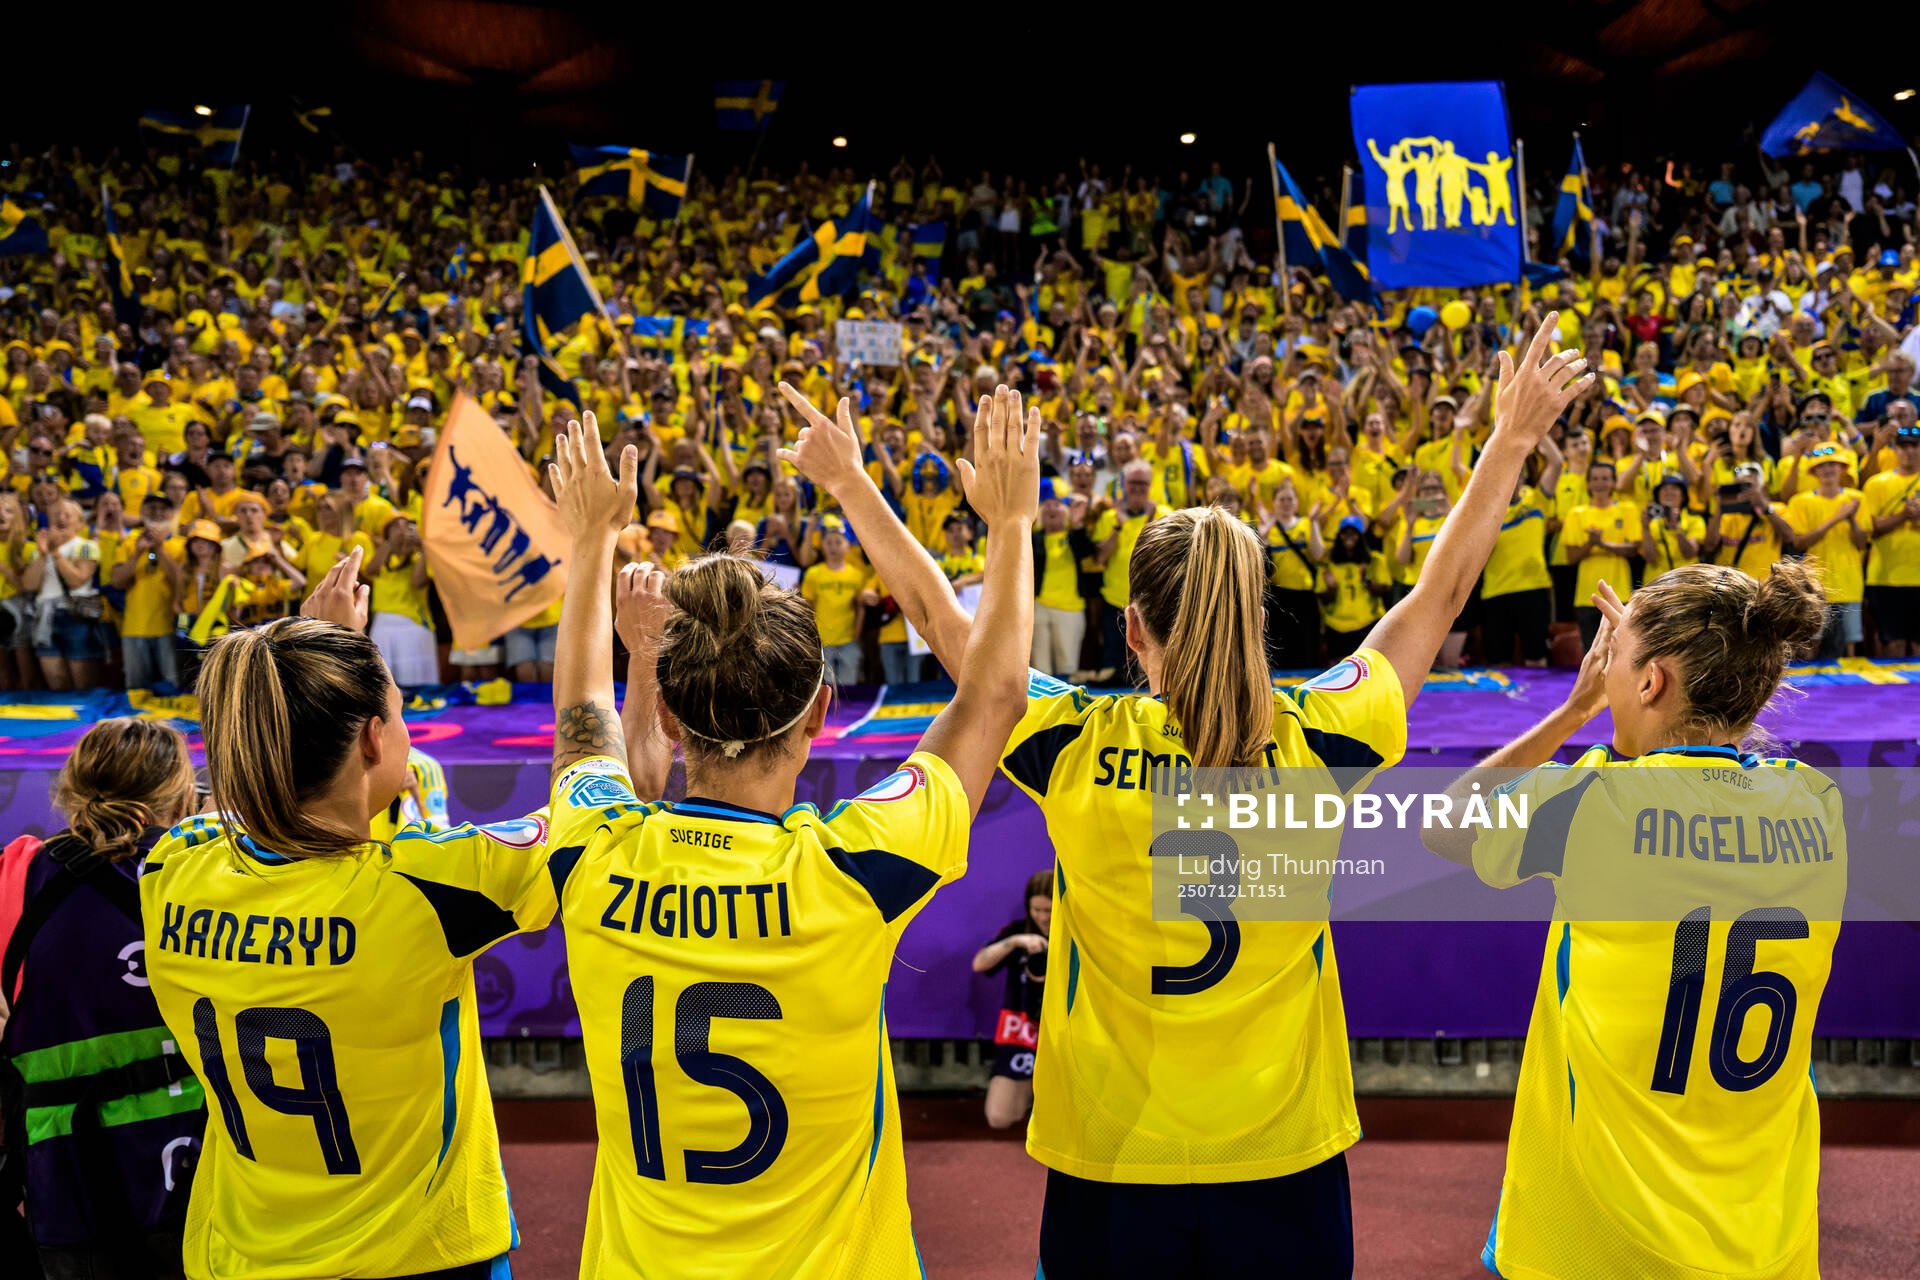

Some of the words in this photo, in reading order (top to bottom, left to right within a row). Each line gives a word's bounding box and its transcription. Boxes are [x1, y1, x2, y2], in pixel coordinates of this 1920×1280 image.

[1094, 742, 1281, 797] SEMBT
[1702, 768, 1755, 790] SVERIGE
[670, 828, 734, 850] SVERIGE
[1633, 807, 1834, 864] ANGELDAHL
[159, 901, 357, 966] KANERYD
[600, 873, 792, 939] ZIGIOTTI
[1148, 829, 1242, 996] 3
[1650, 905, 1810, 1096] 16
[192, 996, 362, 1176] 19
[620, 974, 789, 1185] 15
